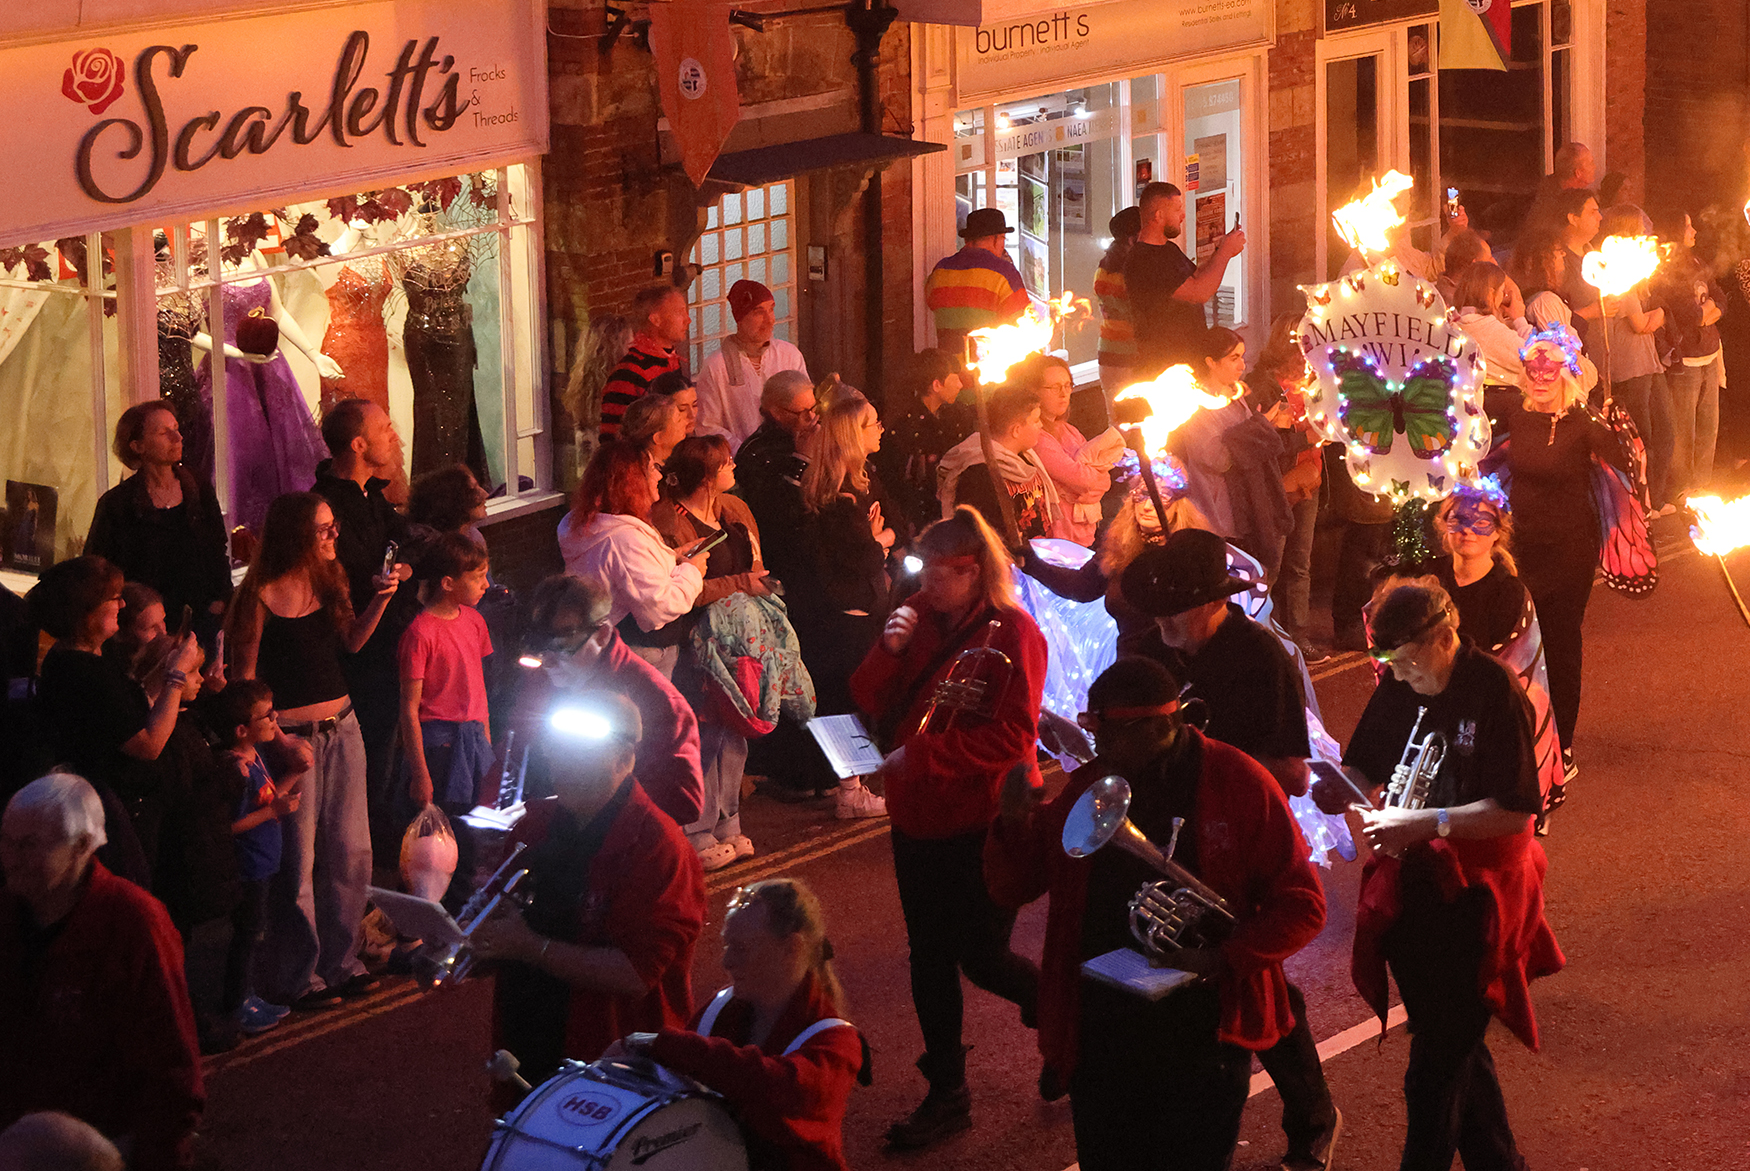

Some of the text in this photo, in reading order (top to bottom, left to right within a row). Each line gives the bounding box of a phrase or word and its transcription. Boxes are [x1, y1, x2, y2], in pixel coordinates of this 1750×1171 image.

[469, 63, 507, 84] Frocks
[470, 88, 481, 107] &
[75, 30, 470, 204] Scarlett's
[472, 105, 520, 129] Threads
[1067, 122, 1087, 138] NAEA
[1308, 312, 1464, 360] MAYFIELD
[562, 1095, 613, 1121] HSB
